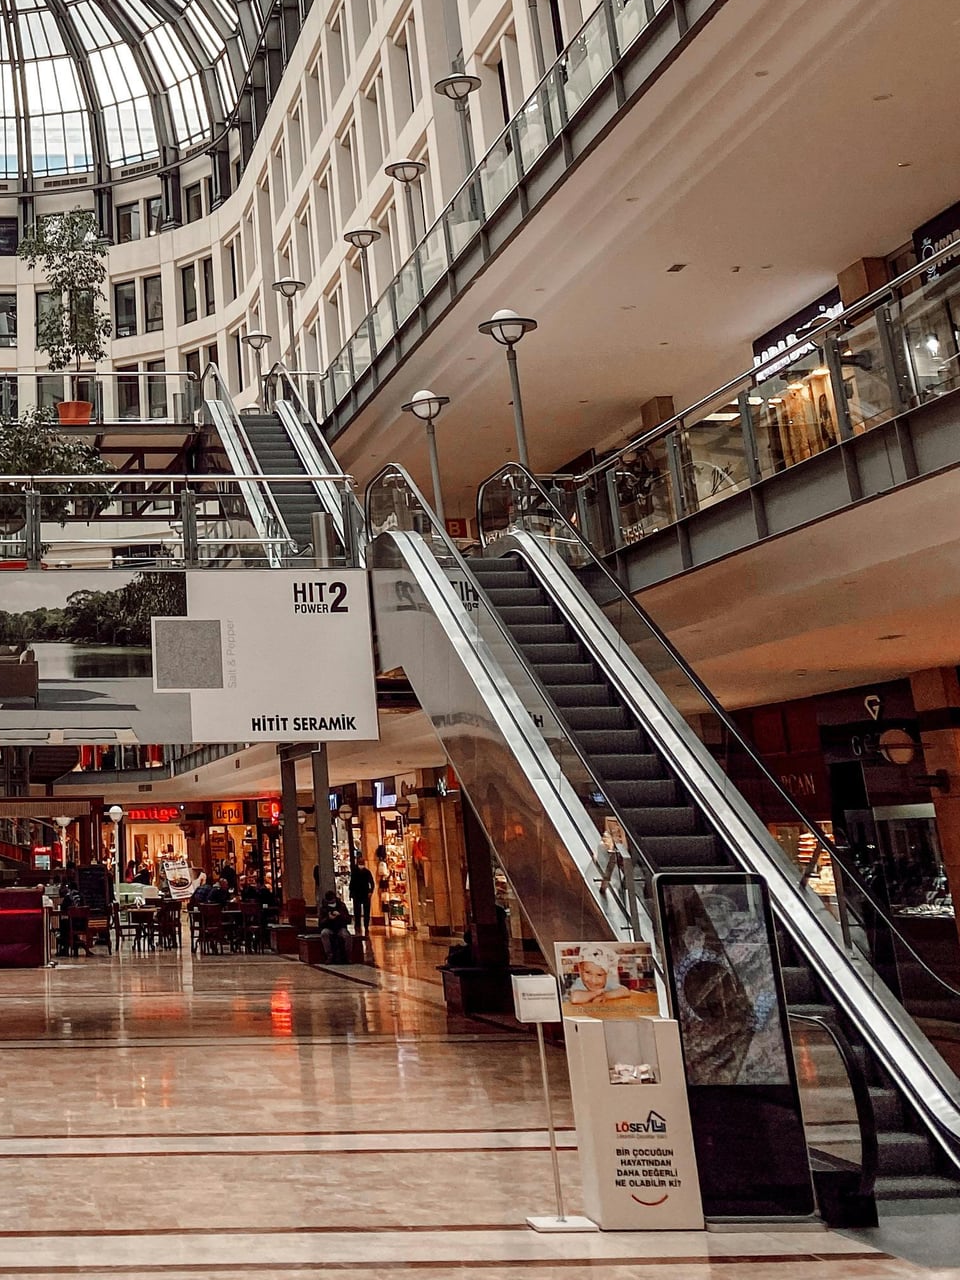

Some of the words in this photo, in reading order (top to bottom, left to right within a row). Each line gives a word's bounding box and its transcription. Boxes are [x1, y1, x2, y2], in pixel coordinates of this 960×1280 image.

[293, 582, 327, 602] HIT
[328, 581, 349, 613] 2
[294, 603, 329, 613] POWER
[251, 715, 289, 732] HİTİT
[293, 713, 357, 731] SERAMİK
[216, 806, 241, 823] depo
[616, 1120, 650, 1133] LÖSEV
[616, 1147, 631, 1157] BİR
[632, 1148, 674, 1158] ÇOCUĞUN
[620, 1159, 672, 1167] HAYATINDAN
[617, 1169, 640, 1177] DAHA
[642, 1168, 679, 1177] DEĞERLİ
[615, 1179, 627, 1187] NE
[628, 1179, 667, 1188] OLABİLİR
